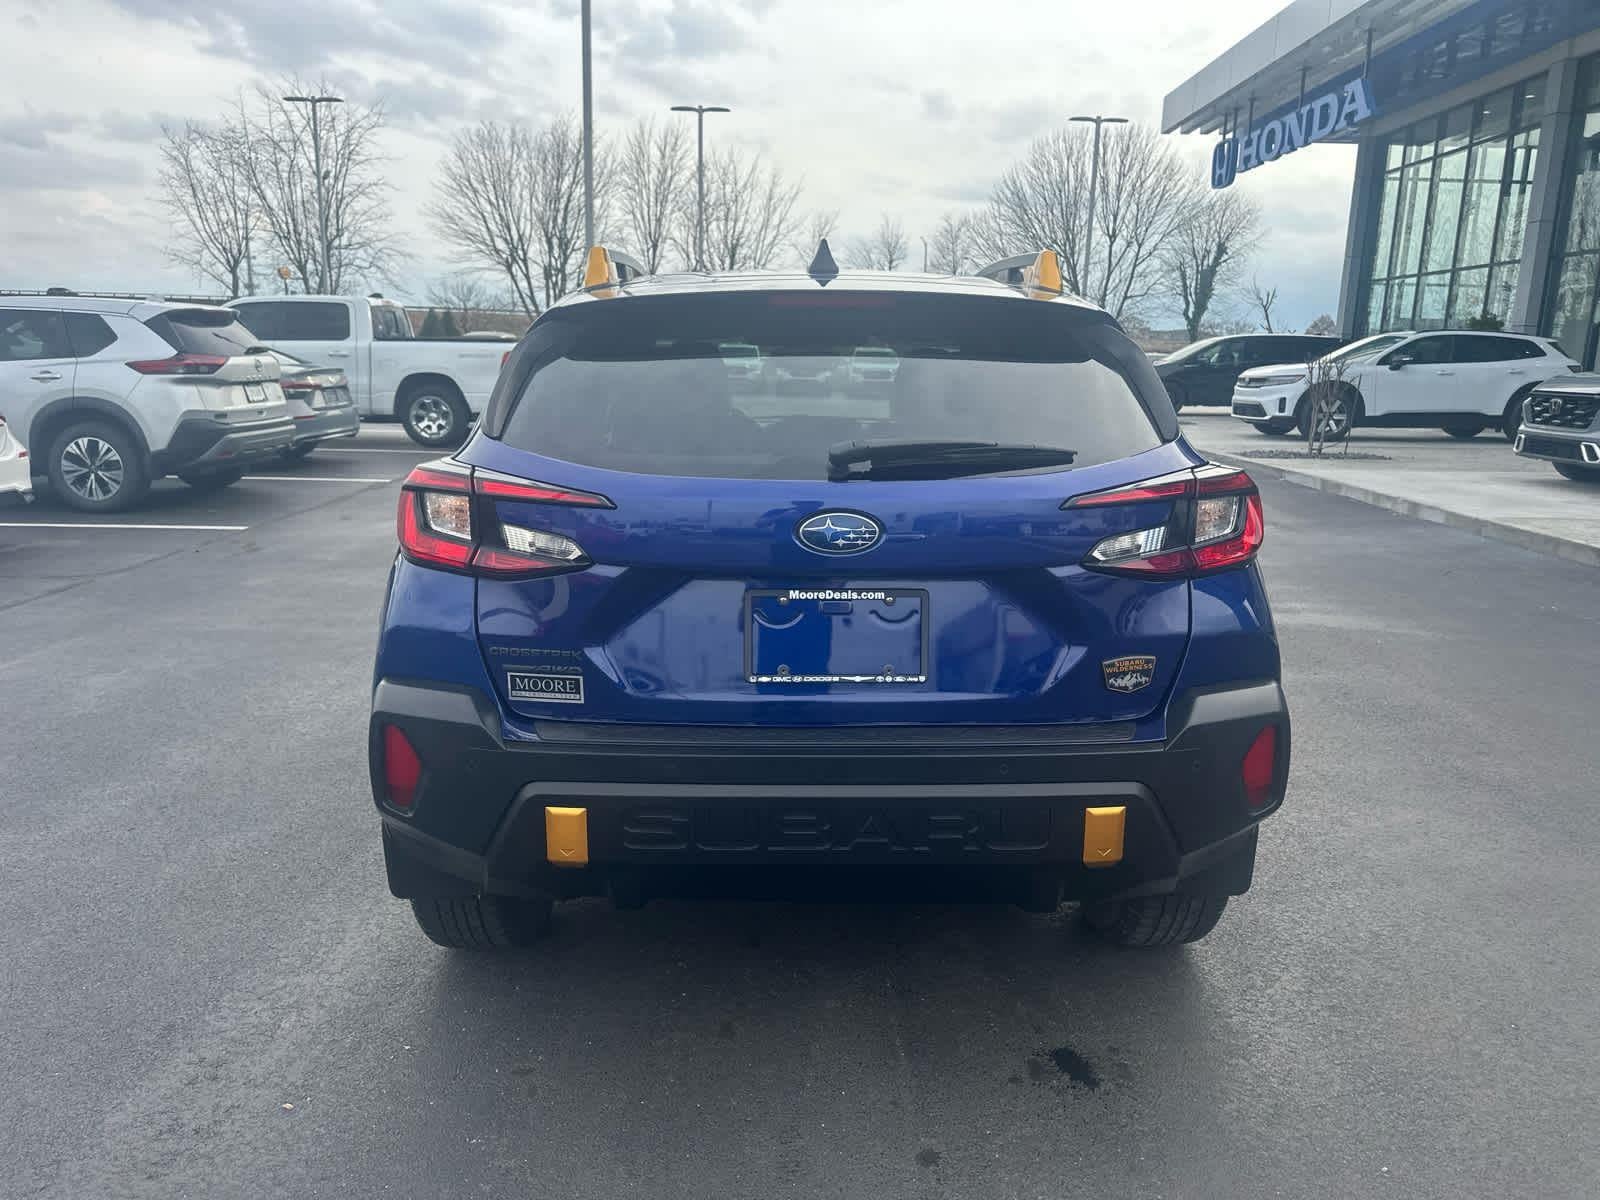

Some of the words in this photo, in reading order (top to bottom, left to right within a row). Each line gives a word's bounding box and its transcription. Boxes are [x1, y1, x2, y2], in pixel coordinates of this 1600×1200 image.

[1236, 78, 1373, 172] HONDA
[789, 589, 885, 600] MooreDeals.com
[489, 647, 582, 657] CROSSTREK
[1106, 664, 1152, 672] WILDERNESS
[1115, 659, 1145, 667] SUBARU
[515, 677, 576, 692] MOORE
[622, 808, 1055, 854] SUBARU
